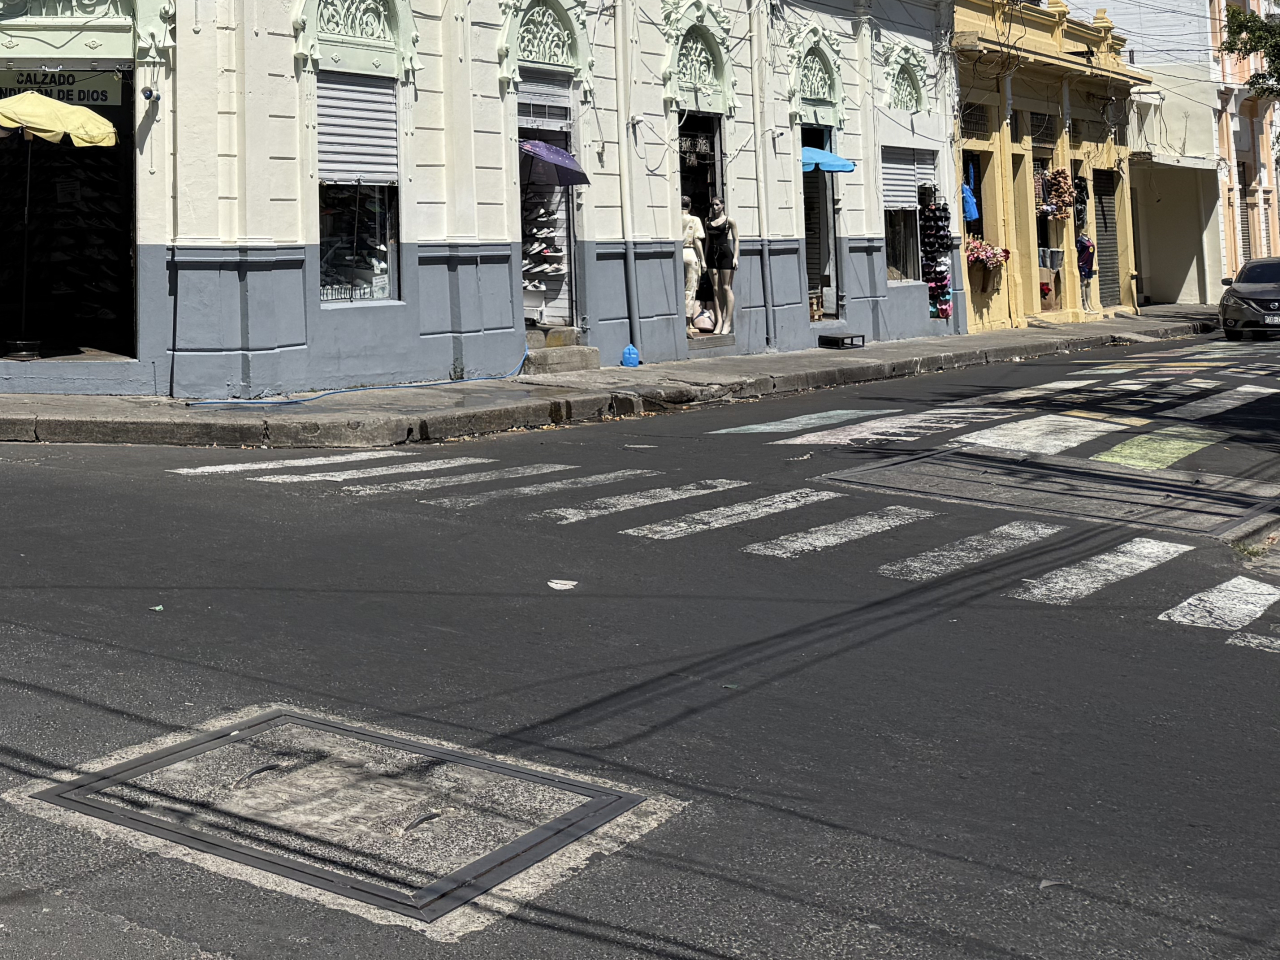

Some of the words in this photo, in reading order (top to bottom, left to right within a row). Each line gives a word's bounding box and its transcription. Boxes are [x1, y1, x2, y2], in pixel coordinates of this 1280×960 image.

[16, 73, 76, 85] CALZADO
[57, 89, 74, 102] DE
[77, 89, 108, 102] DIOS
